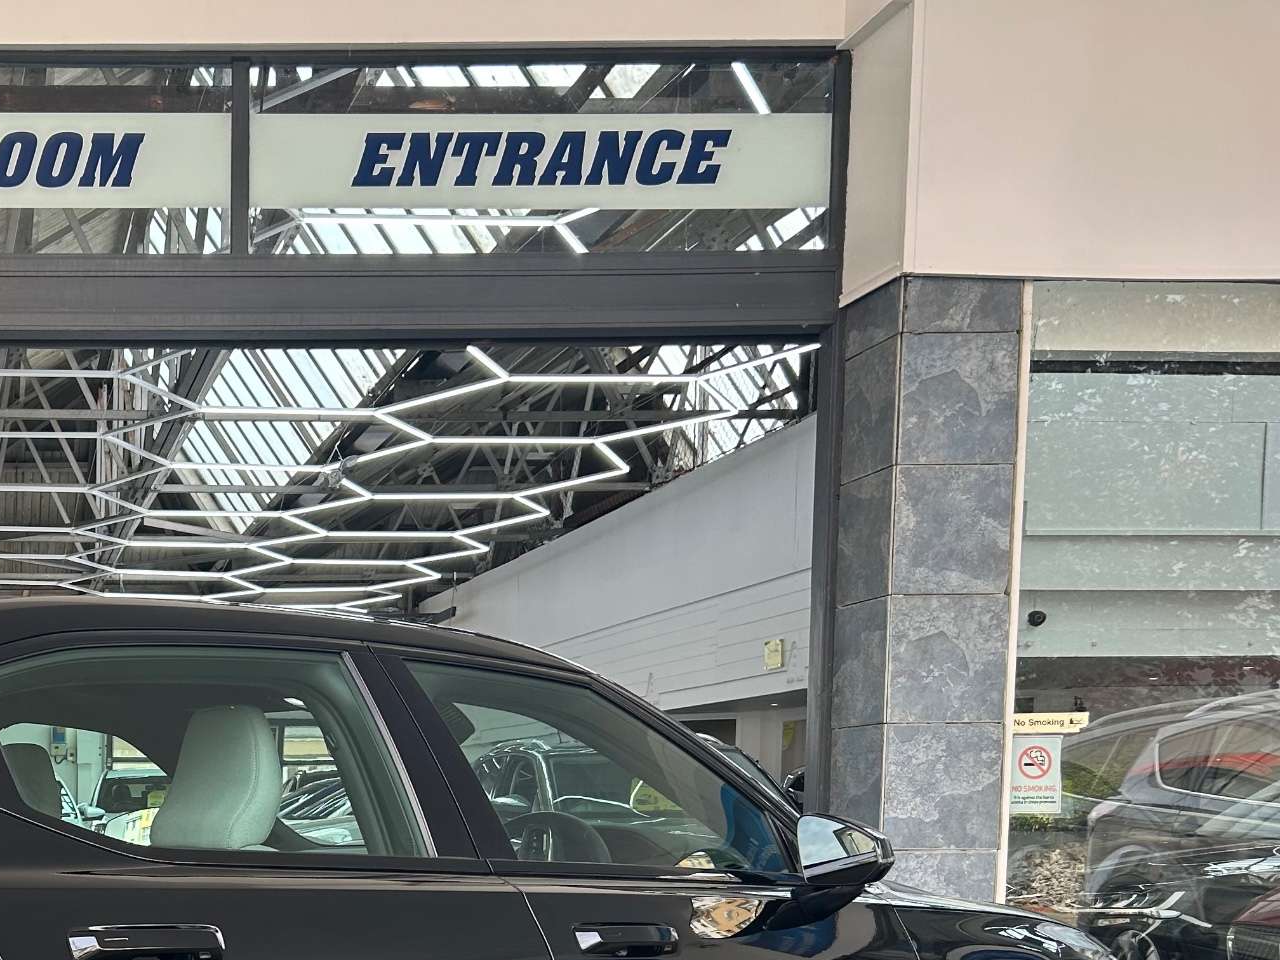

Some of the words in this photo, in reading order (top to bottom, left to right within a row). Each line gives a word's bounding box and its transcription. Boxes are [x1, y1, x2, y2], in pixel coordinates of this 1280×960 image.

[351, 128, 732, 188] ENTRANCE
[1013, 718, 1026, 727] No
[1028, 718, 1065, 728] Smoking
